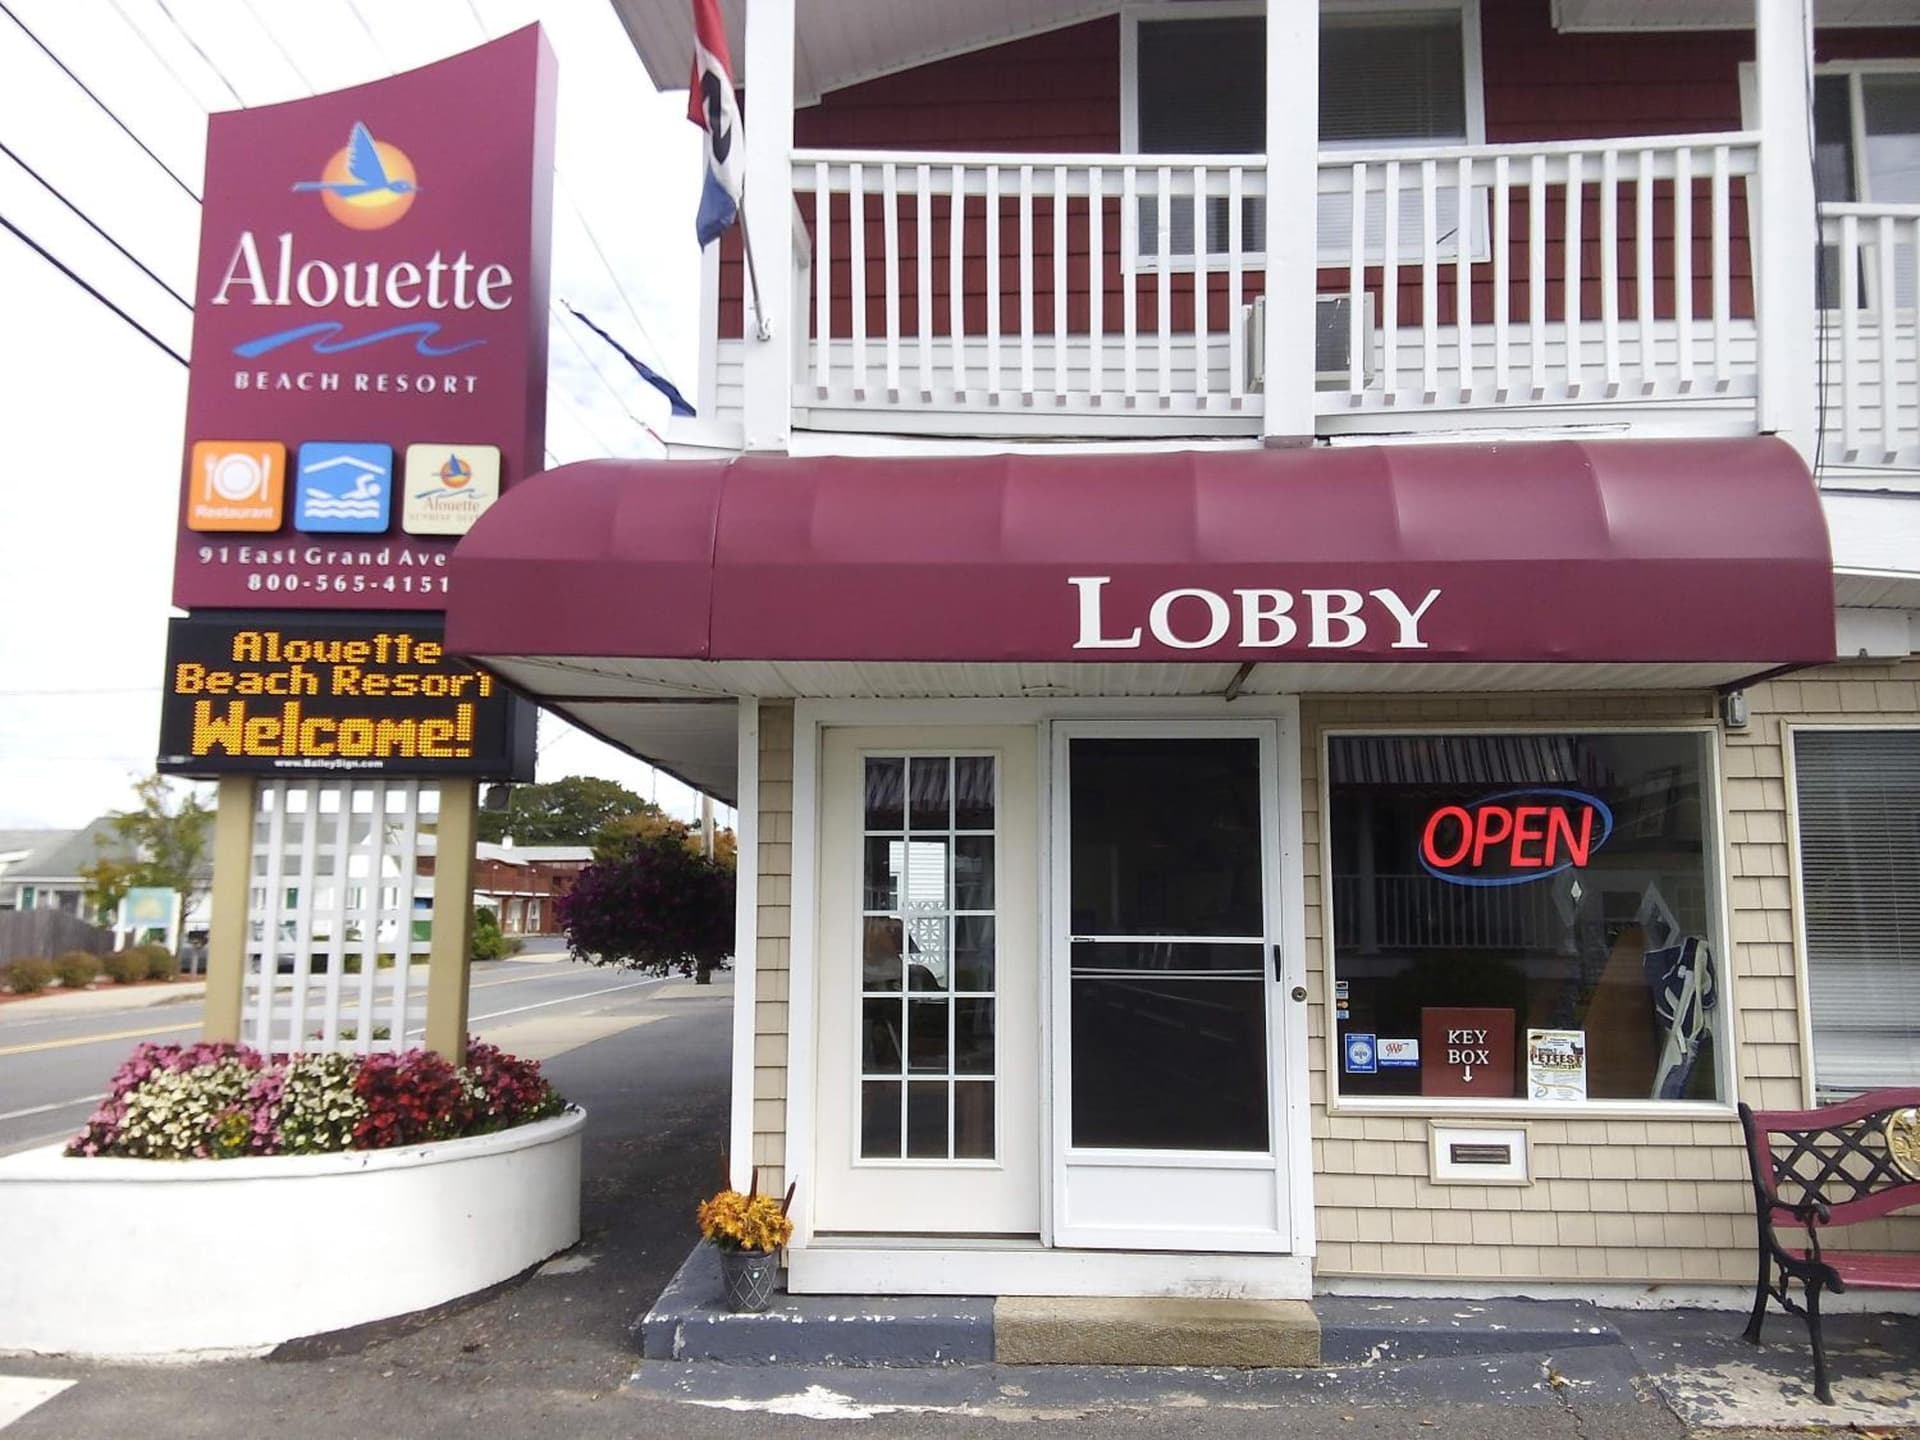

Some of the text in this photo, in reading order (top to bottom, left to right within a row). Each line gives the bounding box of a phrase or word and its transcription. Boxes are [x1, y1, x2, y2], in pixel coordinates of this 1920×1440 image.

[212, 231, 513, 310] Alouette
[235, 371, 478, 394] BEACH RESORT
[199, 546, 447, 567] 91 East Grand Ave
[247, 574, 449, 593] 800-565-4151
[1067, 576, 1442, 649] LOBBY
[231, 632, 442, 664] Alouette
[174, 663, 319, 695] Beach
[191, 700, 473, 757] Welcome!
[1421, 805, 1593, 868] OPEN
[1448, 1029, 1488, 1045] KEY
[1448, 1050, 1489, 1065] BOX
